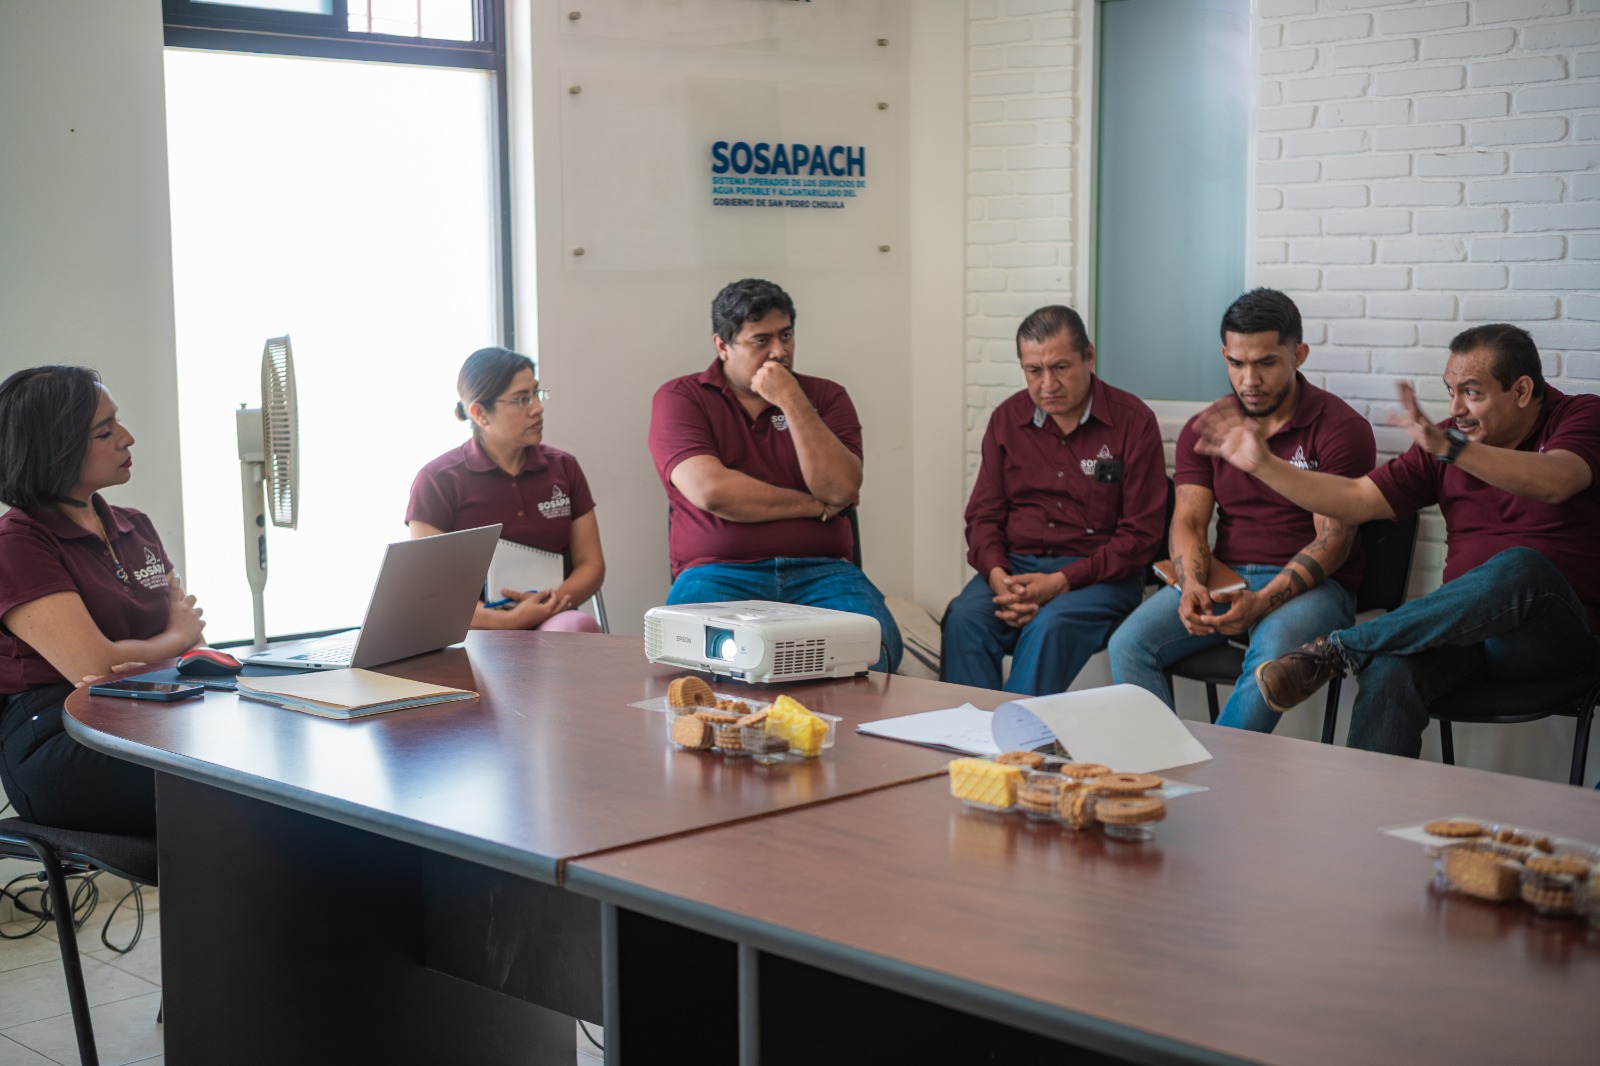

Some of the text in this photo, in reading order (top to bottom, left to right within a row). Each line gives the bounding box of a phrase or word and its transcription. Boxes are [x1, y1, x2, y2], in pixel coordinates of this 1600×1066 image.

[712, 141, 865, 177] SOSAPACH
[713, 176, 866, 188] SISTEMA OPERADOR DE LOS SERVICIOS DE
[712, 186, 857, 197] AGUA POTABLE Y ALCANTARILLADO DEL
[713, 198, 845, 208] GOBIERNO DE SAN PEDRO CHOLULA
[676, 635, 692, 643] EPSON
